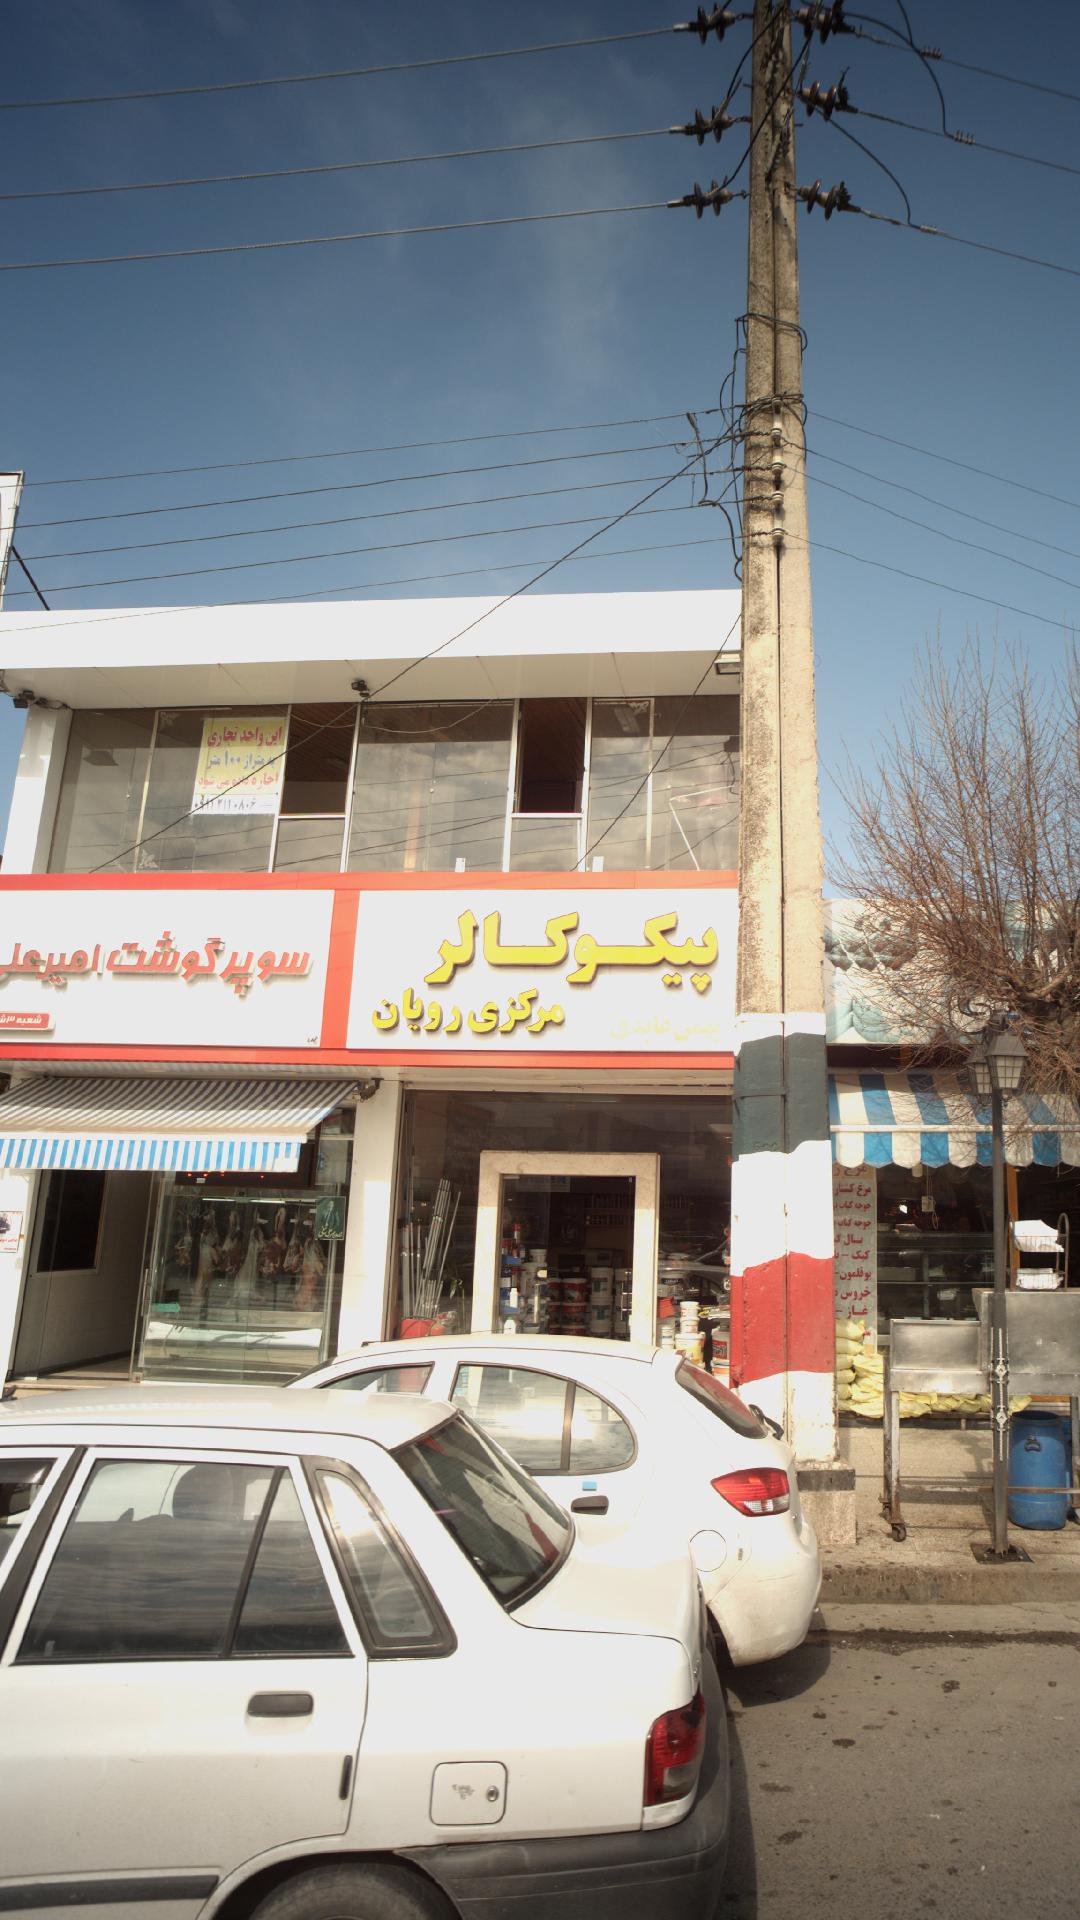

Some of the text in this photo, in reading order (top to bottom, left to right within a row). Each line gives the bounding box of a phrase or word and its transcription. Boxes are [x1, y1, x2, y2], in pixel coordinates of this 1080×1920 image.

[207, 726, 283, 747] این واحد تجاری
[207, 755, 222, 769] متر
[224, 749, 241, 768] ۱۰۰
[106, 931, 222, 981] گوشت
[219, 948, 310, 995] سوپر
[372, 988, 566, 1033] مرکزی رویان
[16, 1014, 42, 1026] شعبه
[856, 1182, 872, 1197] مرغ
[854, 1202, 872, 1213] جوجه
[854, 1219, 872, 1231] جوجه
[839, 1265, 872, 1282] بوقلمون
[840, 1287, 872, 1302] خروس
[846, 1304, 869, 1320] غاز
